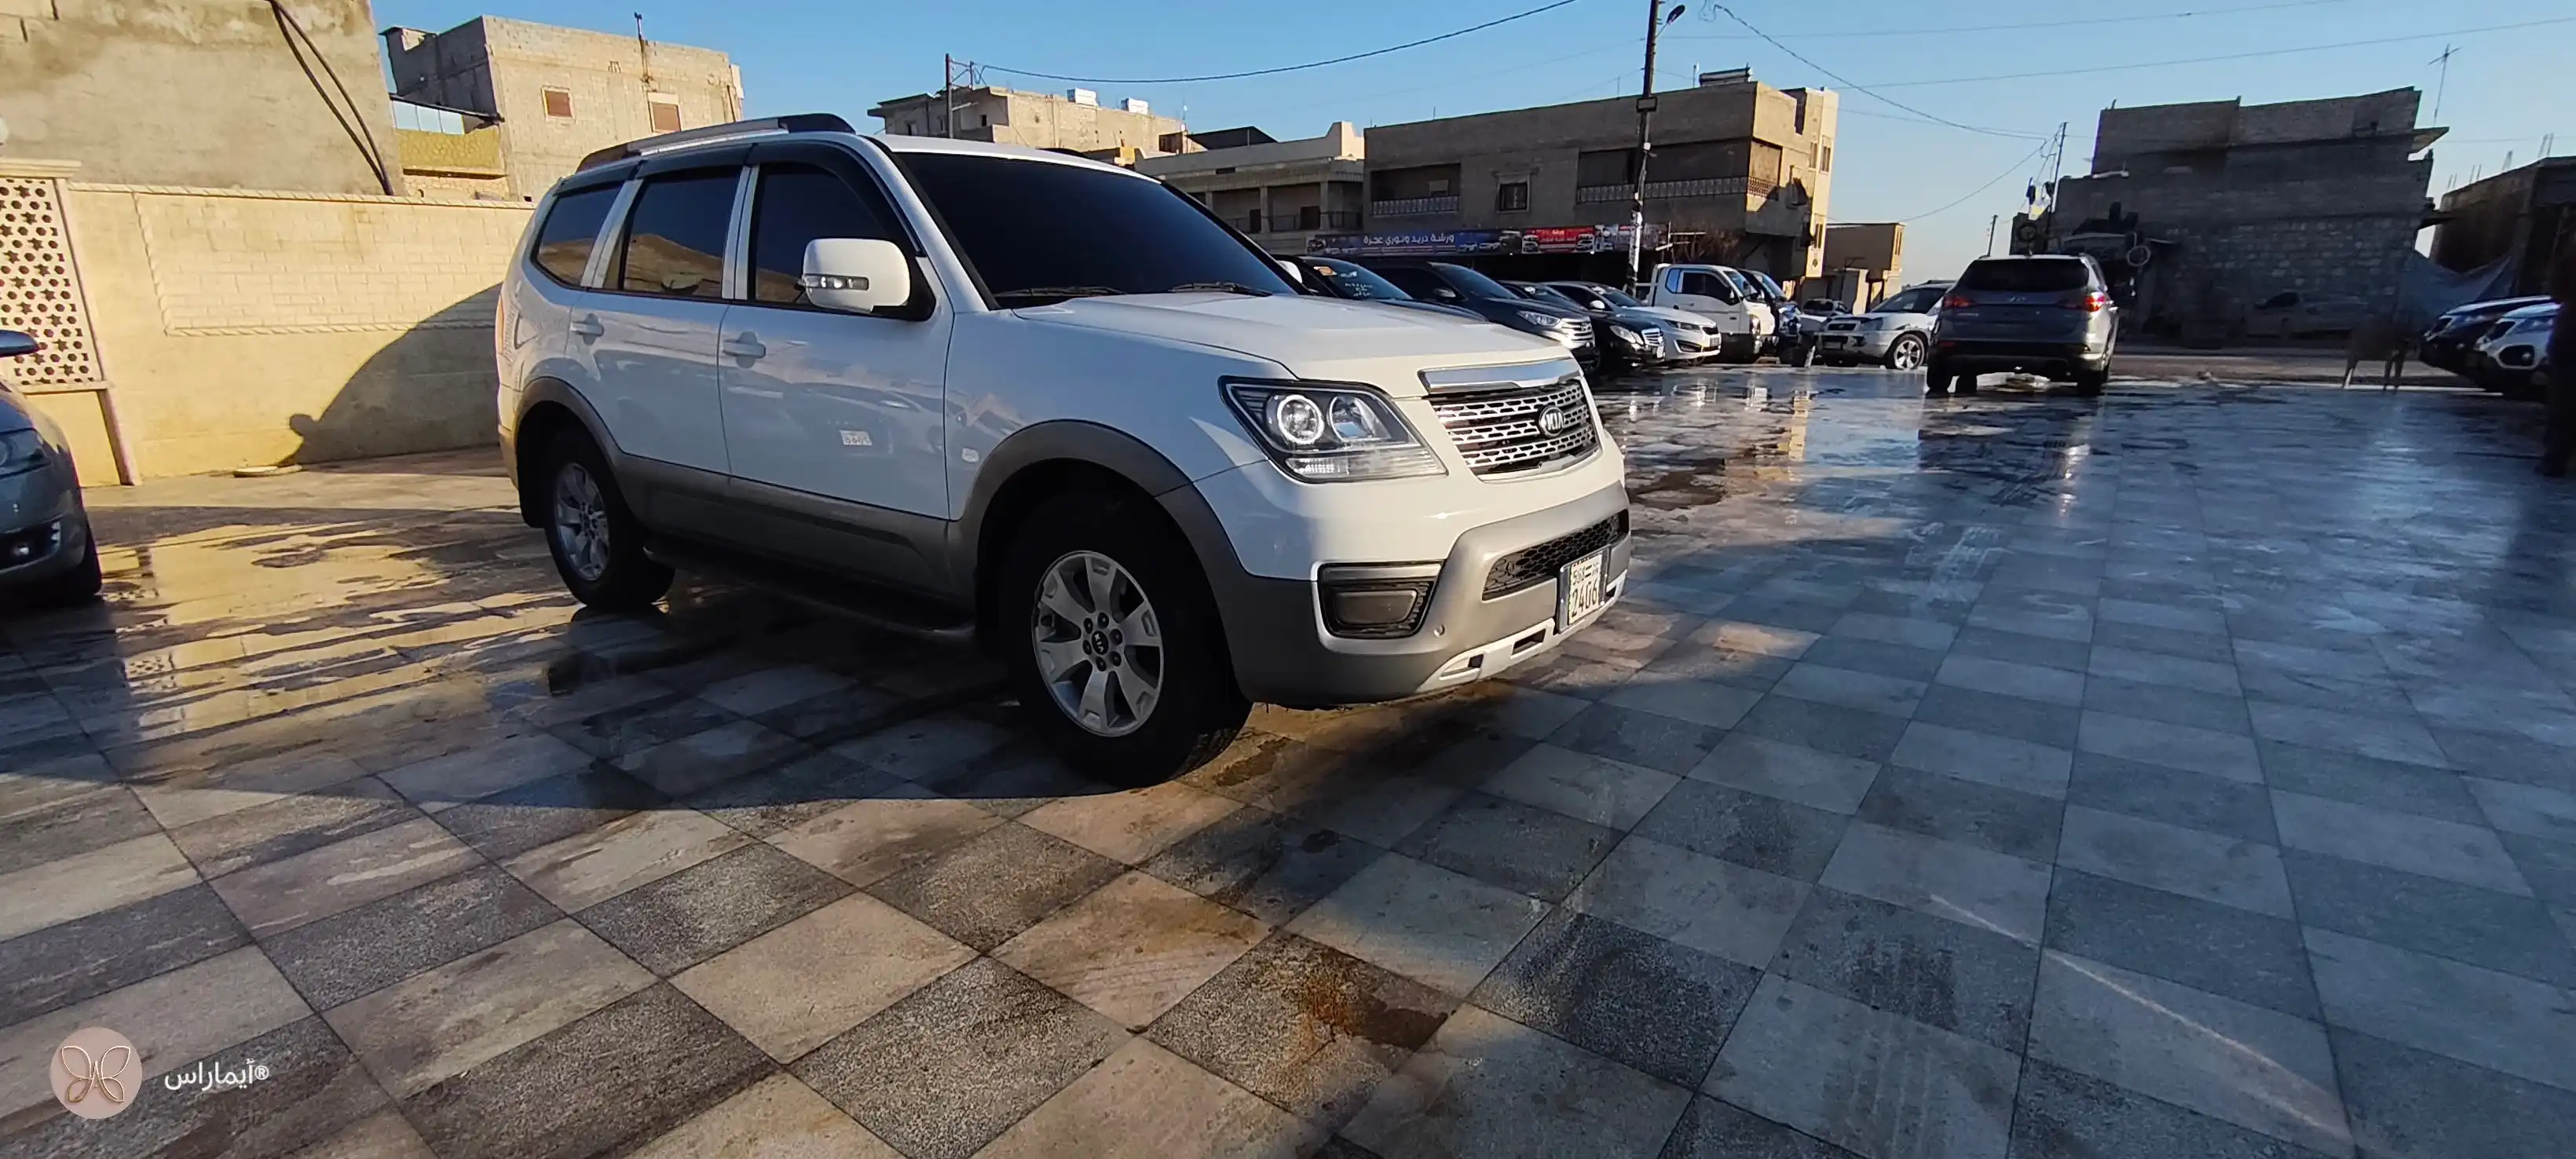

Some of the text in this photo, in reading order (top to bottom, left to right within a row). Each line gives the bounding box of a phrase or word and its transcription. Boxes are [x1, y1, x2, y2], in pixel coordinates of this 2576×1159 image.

[1430, 232, 1454, 243] ورشة
[1546, 411, 1564, 430] KIA
[1572, 578, 1598, 617] 2406
